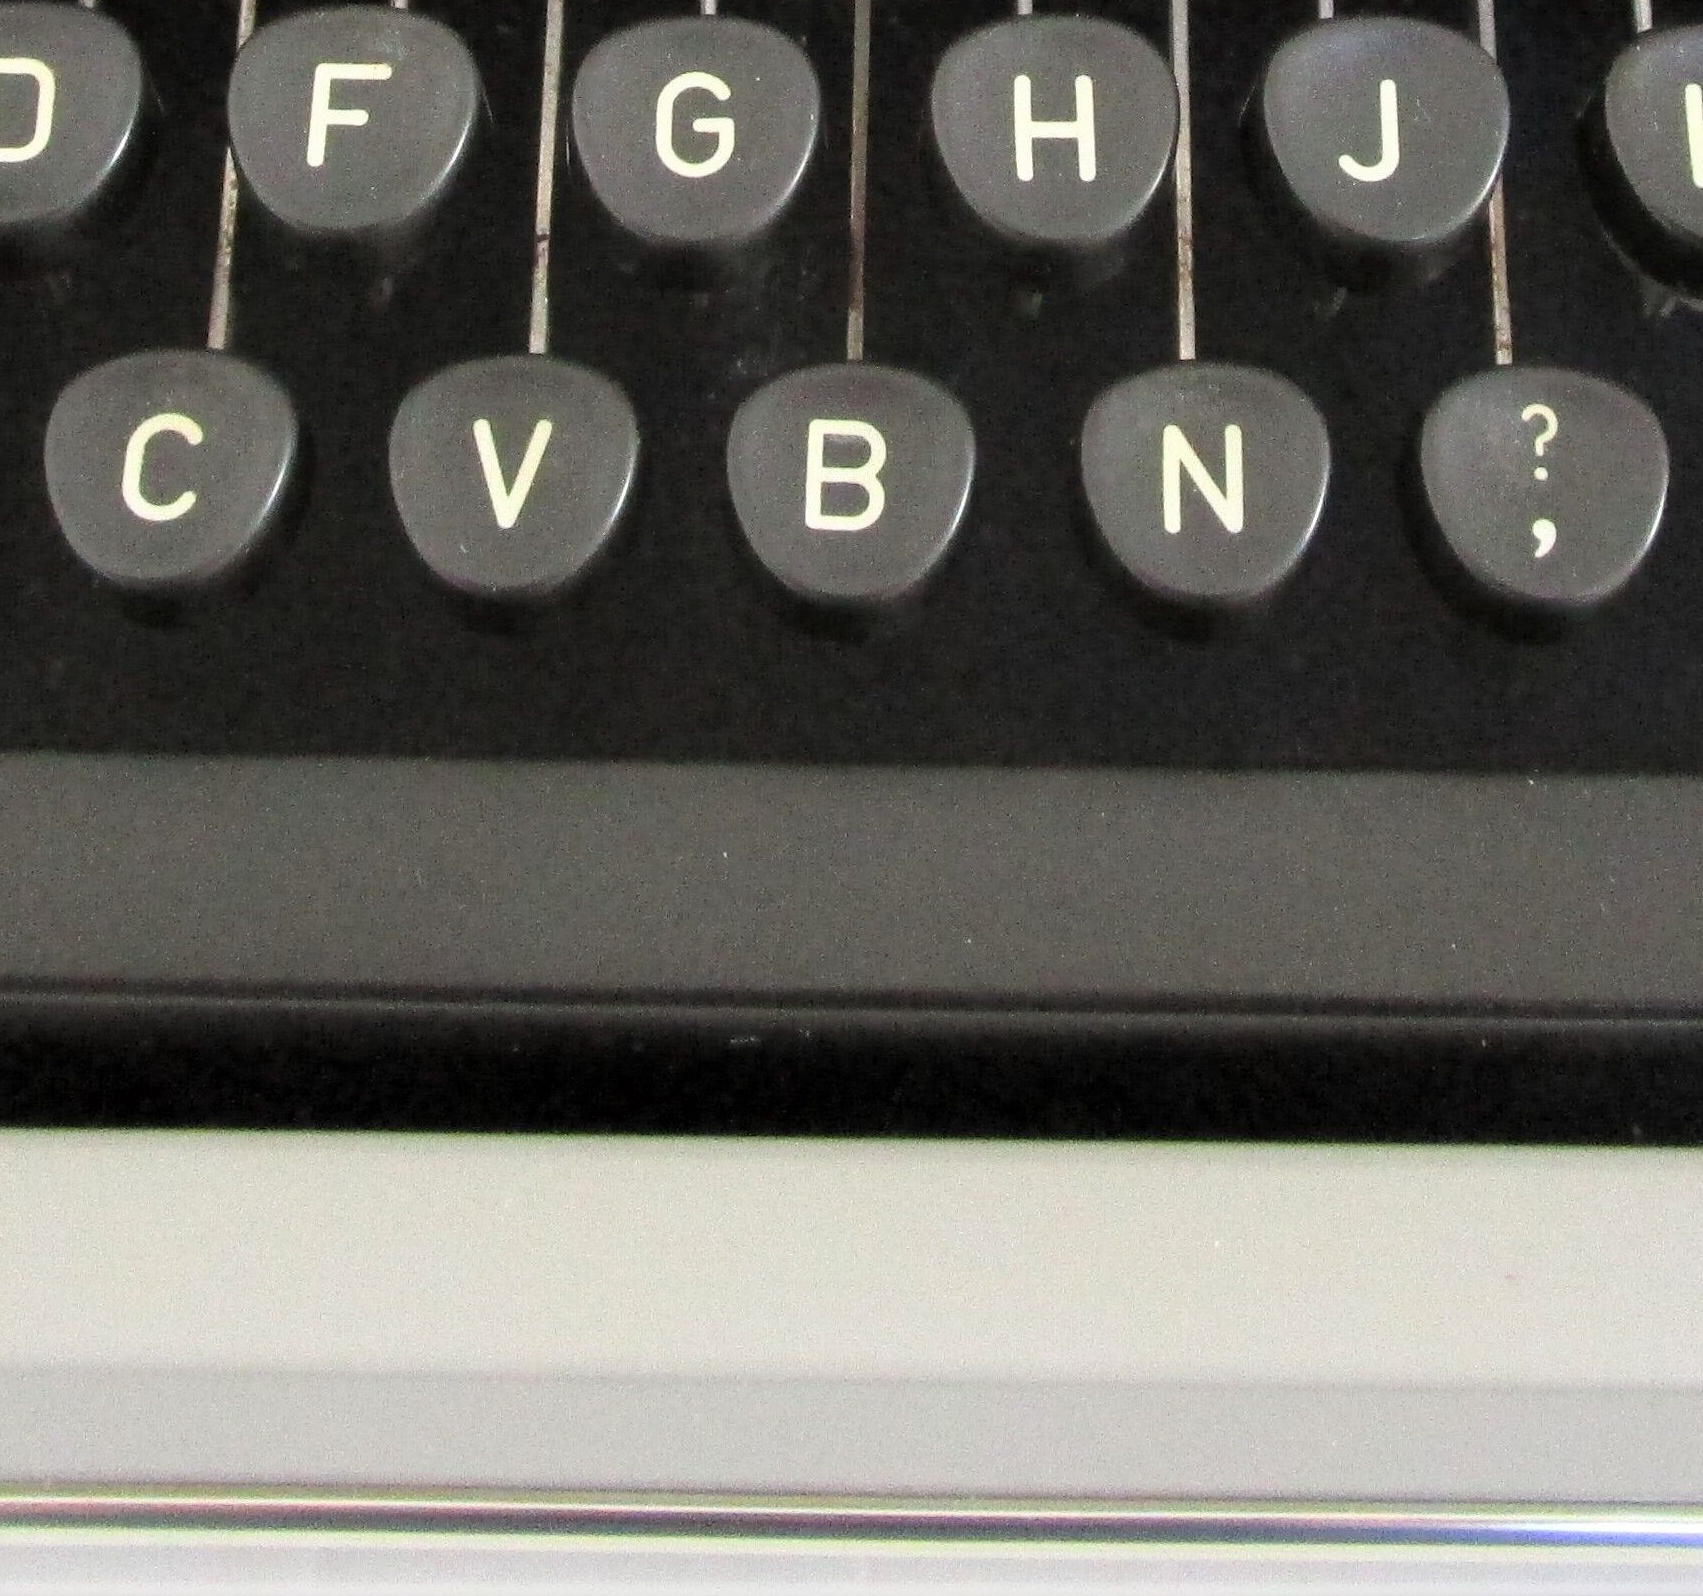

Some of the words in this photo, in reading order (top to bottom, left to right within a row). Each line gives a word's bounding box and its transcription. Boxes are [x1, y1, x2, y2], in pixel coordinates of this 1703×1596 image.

[304, 61, 395, 170] F
[653, 69, 737, 180] G
[1011, 72, 1098, 184] H
[1336, 77, 1402, 184] J
[120, 410, 205, 524] C
[471, 417, 555, 531] V
[803, 417, 888, 534] B
[1160, 422, 1246, 536] N
[1518, 401, 1560, 483] ?
